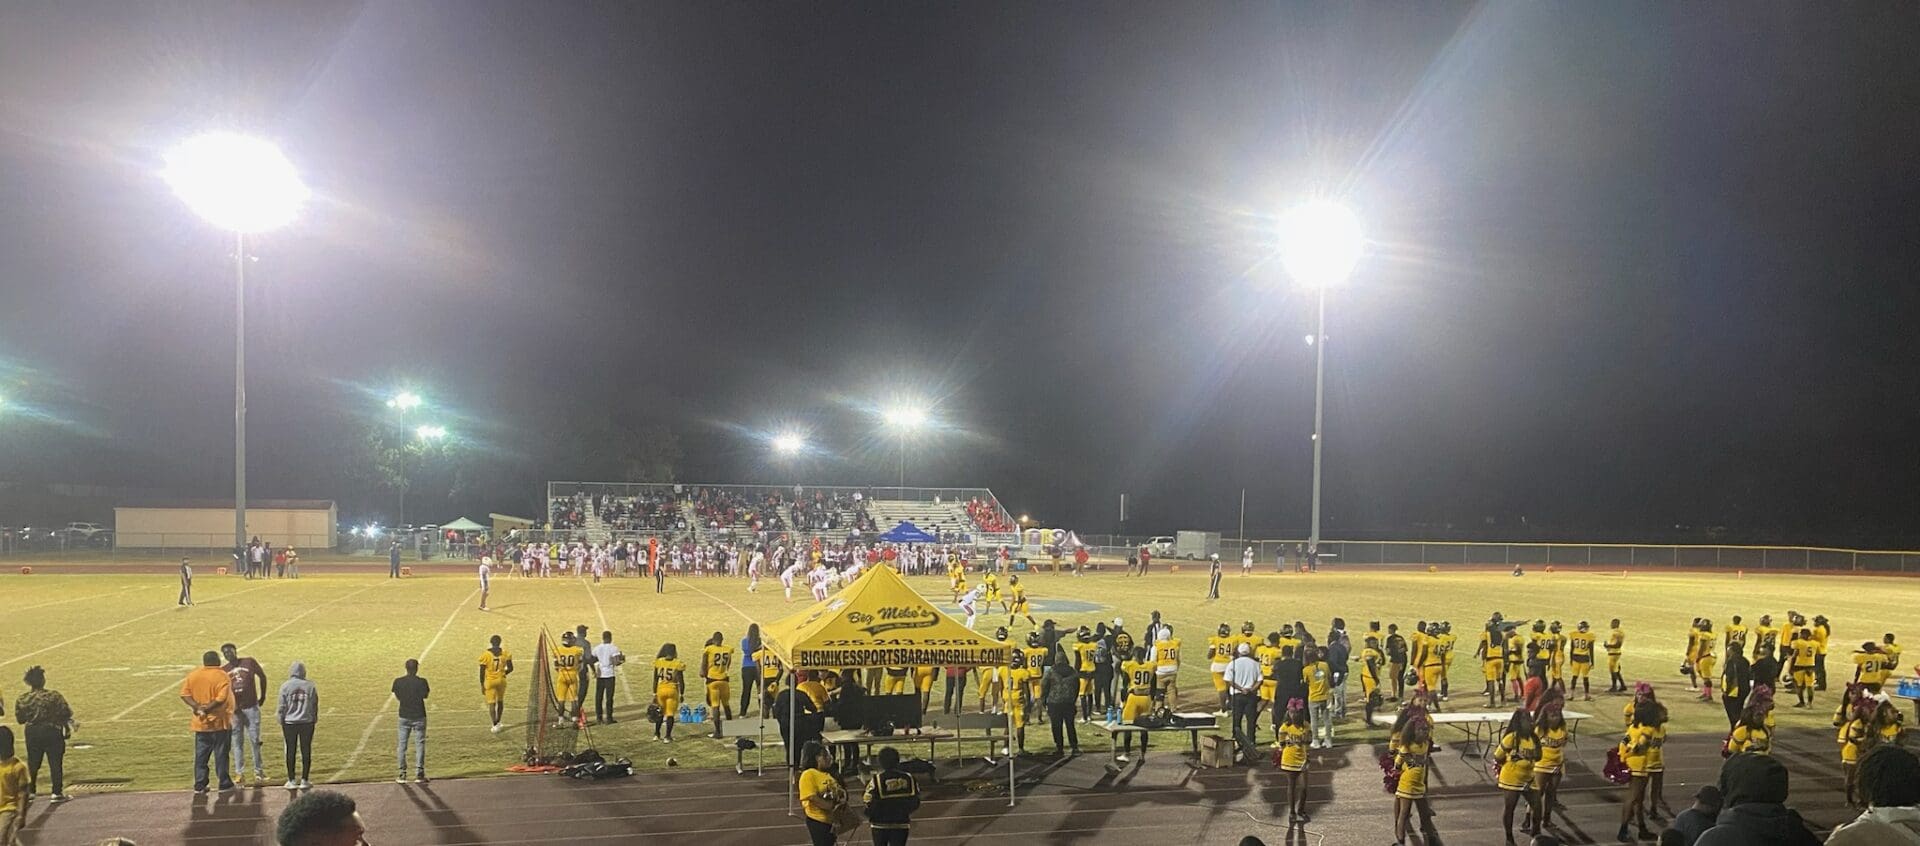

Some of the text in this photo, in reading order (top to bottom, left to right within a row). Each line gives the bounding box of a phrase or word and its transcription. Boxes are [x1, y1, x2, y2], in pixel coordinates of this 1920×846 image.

[847, 606, 928, 625] Big Mike's
[1163, 649, 1176, 660] 70
[1218, 643, 1231, 656] 64
[713, 653, 729, 666] 25
[801, 648, 1004, 667] BIGMIKESSPORTSBARANDGRILL.COM
[493, 659, 500, 672] 7
[1865, 661, 1879, 673] 21
[1134, 671, 1150, 685] 90
